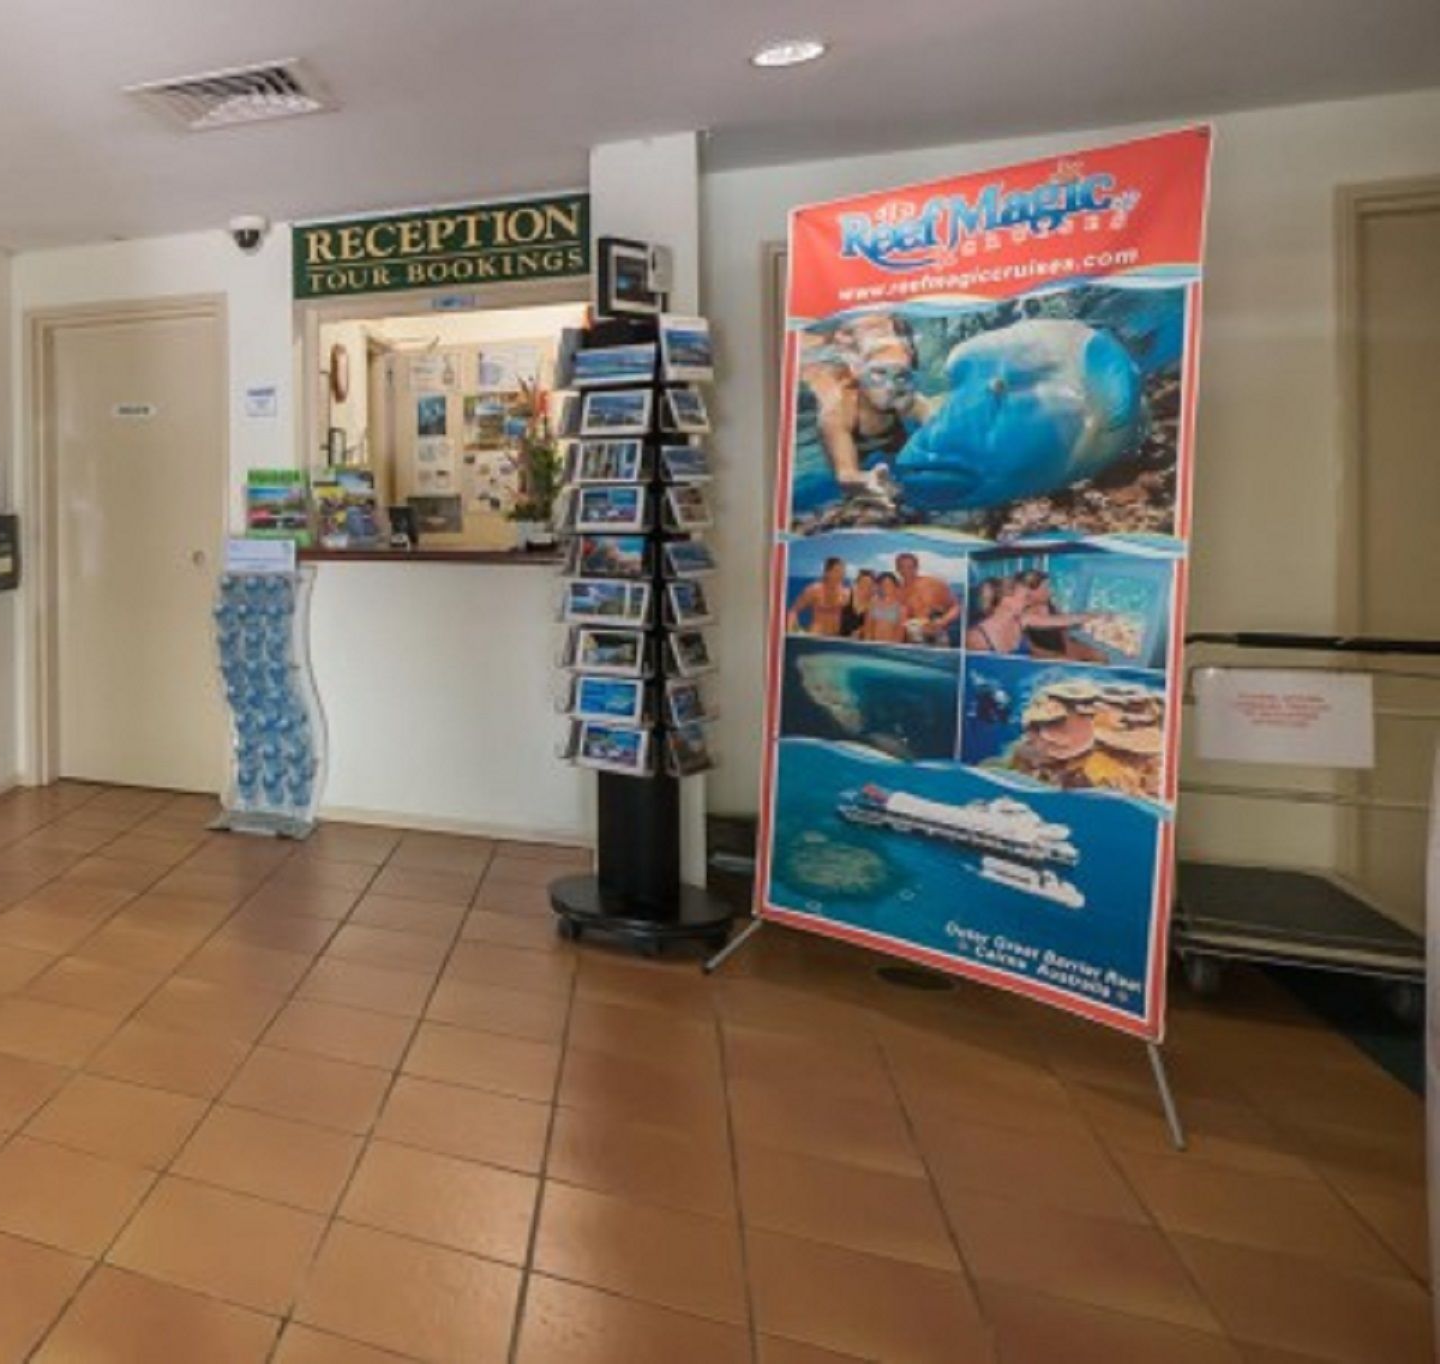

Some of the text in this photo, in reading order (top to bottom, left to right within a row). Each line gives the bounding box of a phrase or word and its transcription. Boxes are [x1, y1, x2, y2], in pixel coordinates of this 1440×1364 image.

[305, 202, 582, 264] RECEPTION
[839, 172, 1116, 266] Reef Magic
[307, 246, 583, 293] TOUR BOOKINGS
[838, 247, 1140, 301] www.reefmagiccruises.com
[945, 919, 990, 945] Outer
[1043, 950, 1103, 978] Barrier
